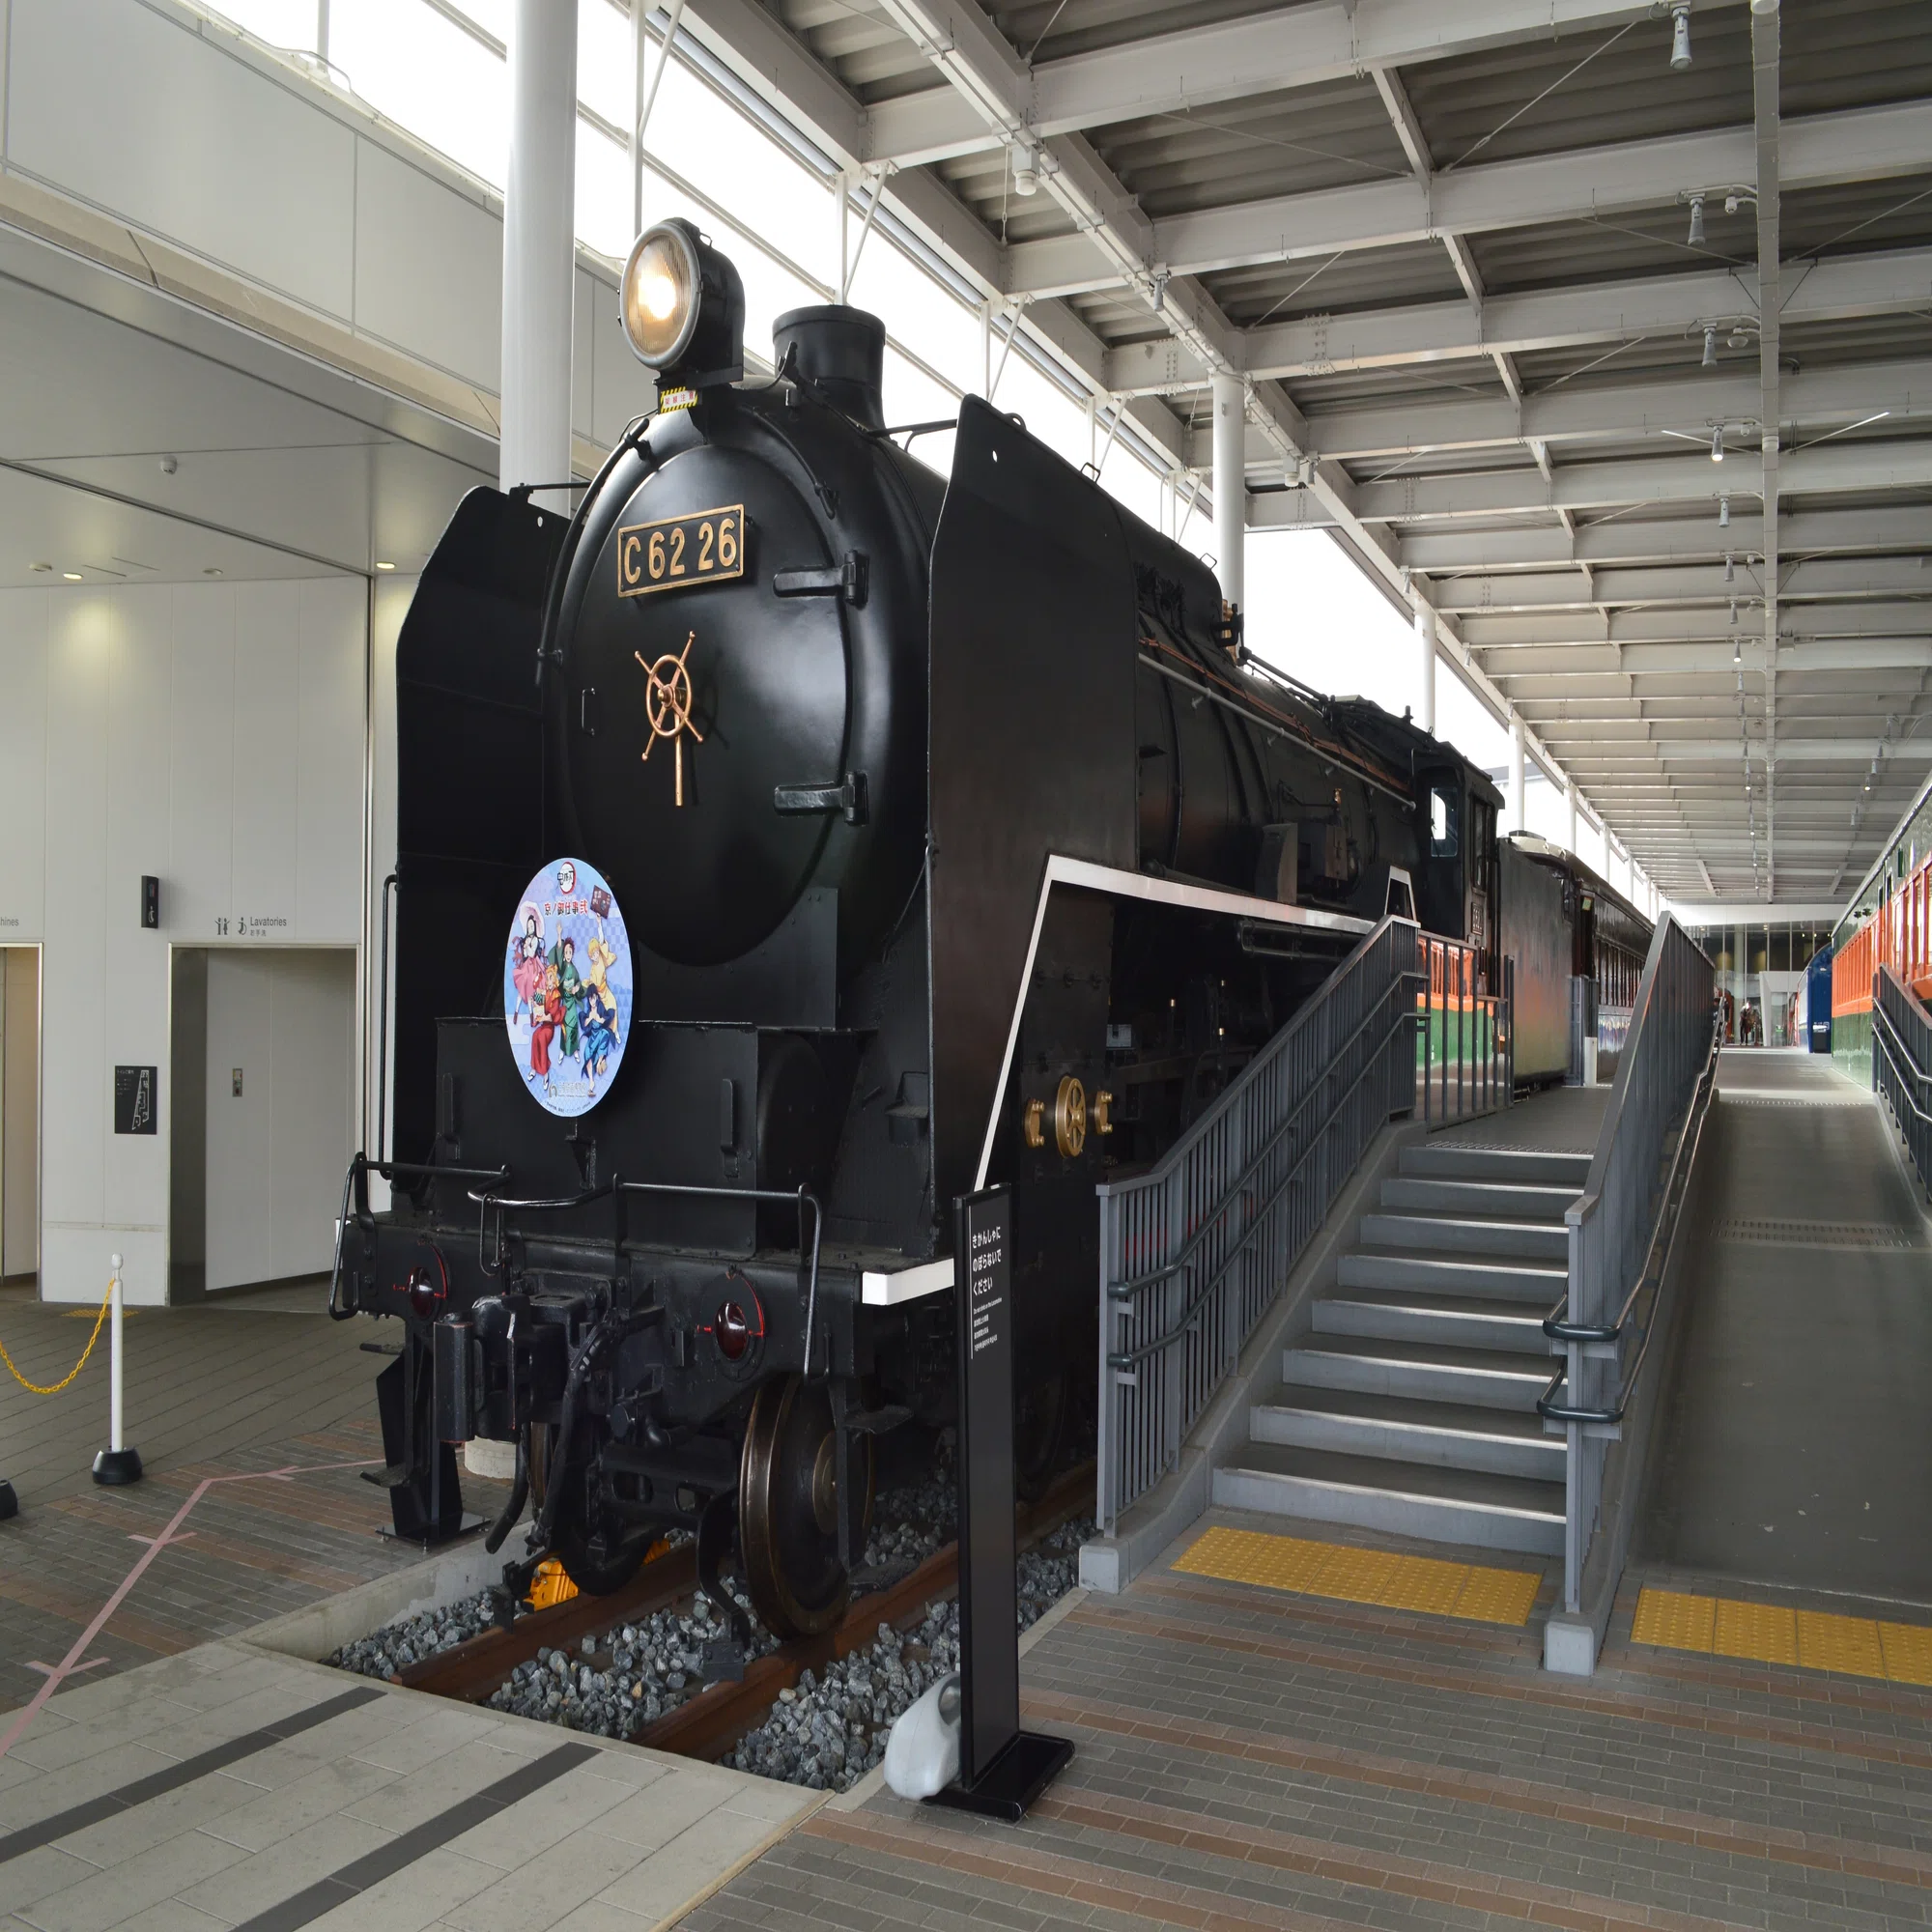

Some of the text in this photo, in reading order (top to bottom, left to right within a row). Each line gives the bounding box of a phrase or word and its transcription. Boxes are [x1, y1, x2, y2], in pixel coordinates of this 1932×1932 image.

[624, 518, 737, 584] C62 26
[250, 917, 287, 926] Lavatories
[973, 1226, 1001, 1249] きかんしゃに
[973, 1249, 1002, 1272] のぼらないで
[974, 1277, 993, 1296] ください
